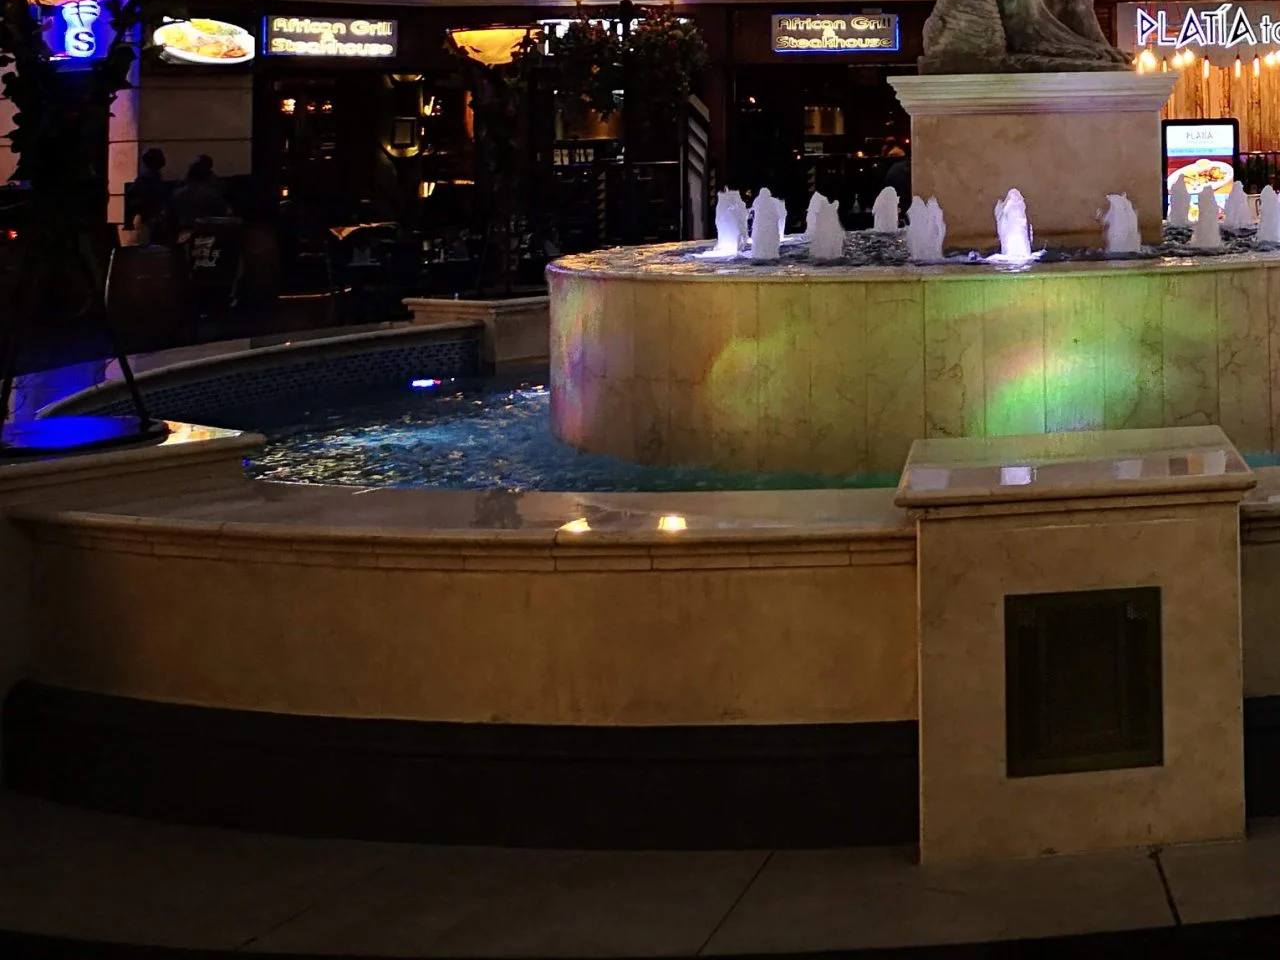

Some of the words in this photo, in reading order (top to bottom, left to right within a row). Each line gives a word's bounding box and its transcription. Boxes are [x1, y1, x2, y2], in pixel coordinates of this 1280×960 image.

[272, 17, 347, 35] African
[350, 20, 393, 36] Grill
[777, 16, 847, 30] African
[850, 16, 892, 31] Grill
[271, 37, 394, 56] Steakhouse
[776, 35, 893, 49] Steakhouse
